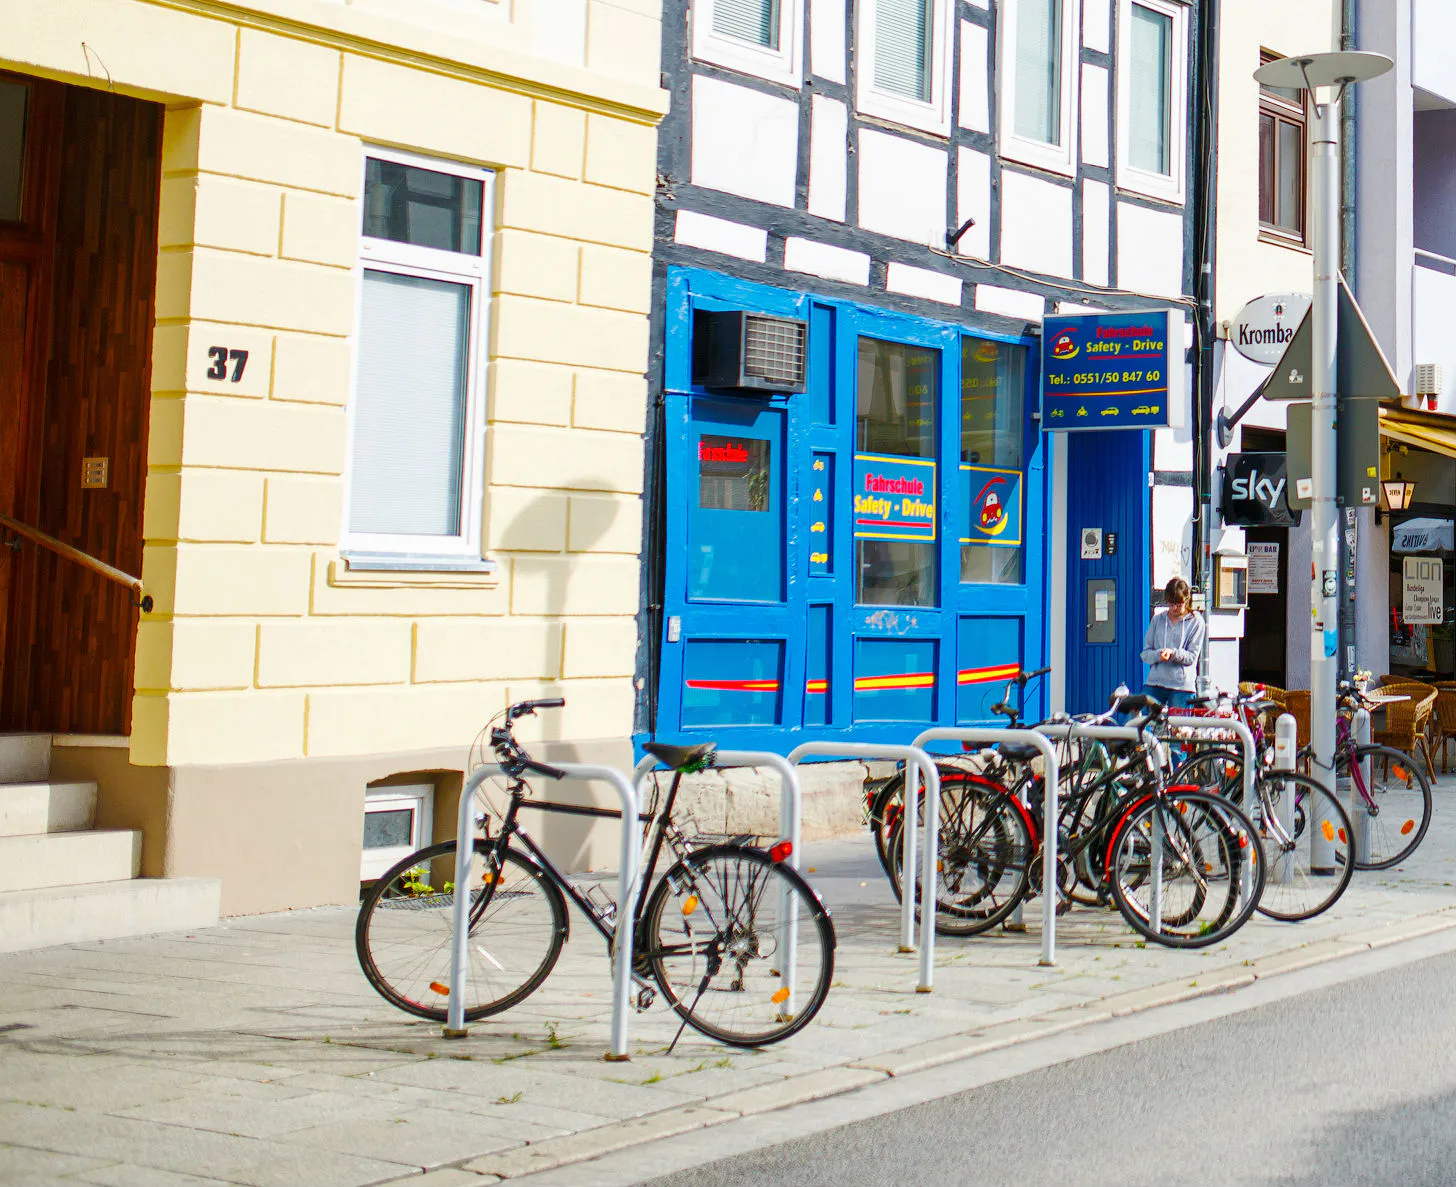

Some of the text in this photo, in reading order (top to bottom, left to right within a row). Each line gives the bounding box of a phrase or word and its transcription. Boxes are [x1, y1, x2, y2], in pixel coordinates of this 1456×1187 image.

[1096, 324, 1154, 338] Fahrschule
[1086, 341, 1121, 354] Safety
[1132, 339, 1164, 351] Drive
[207, 346, 248, 383] 37
[1049, 370, 1160, 385] Tel.: 0551/50 847 60
[865, 473, 924, 495] Fahrschule
[1231, 469, 1287, 509] sky
[854, 495, 892, 519] Safety
[902, 497, 934, 518] Drive
